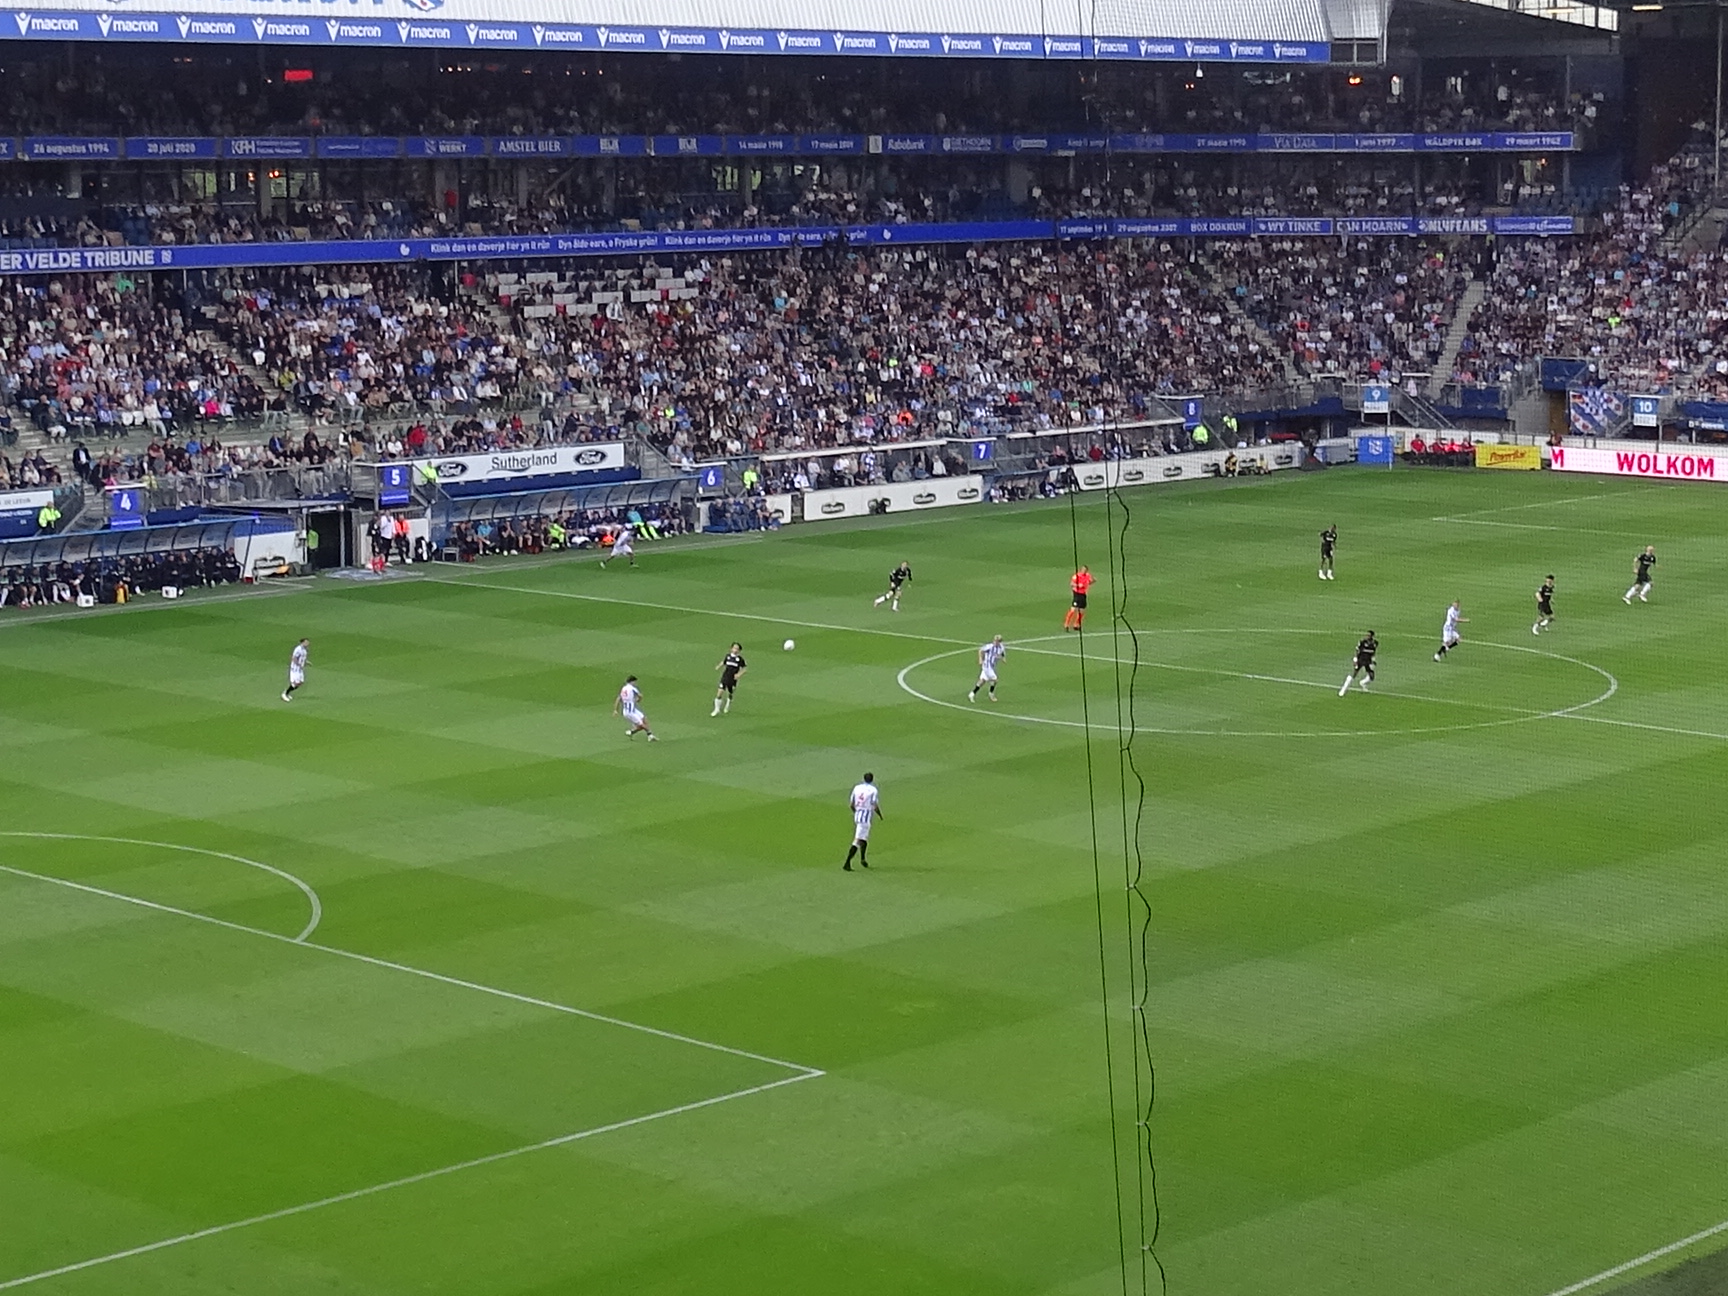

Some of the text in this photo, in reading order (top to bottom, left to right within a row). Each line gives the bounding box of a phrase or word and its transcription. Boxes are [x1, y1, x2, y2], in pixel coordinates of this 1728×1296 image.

[31, 17, 78, 32] macron
[113, 19, 158, 32] macron
[191, 21, 235, 34] macron
[267, 22, 309, 36] macron
[340, 24, 381, 38] macron
[410, 26, 450, 39] macron
[479, 27, 517, 40] macron
[499, 140, 561, 152] AMSTEL BIER
[25, 251, 81, 269] VELDE
[83, 249, 154, 267] TRIBUNE
[1639, 401, 1652, 412] 10
[979, 444, 987, 459] 7
[491, 452, 557, 470] Sutherland
[1617, 453, 1715, 479] WOLKOM
[391, 469, 400, 486] 5
[707, 470, 715, 486] 6
[120, 493, 132, 510] 4
